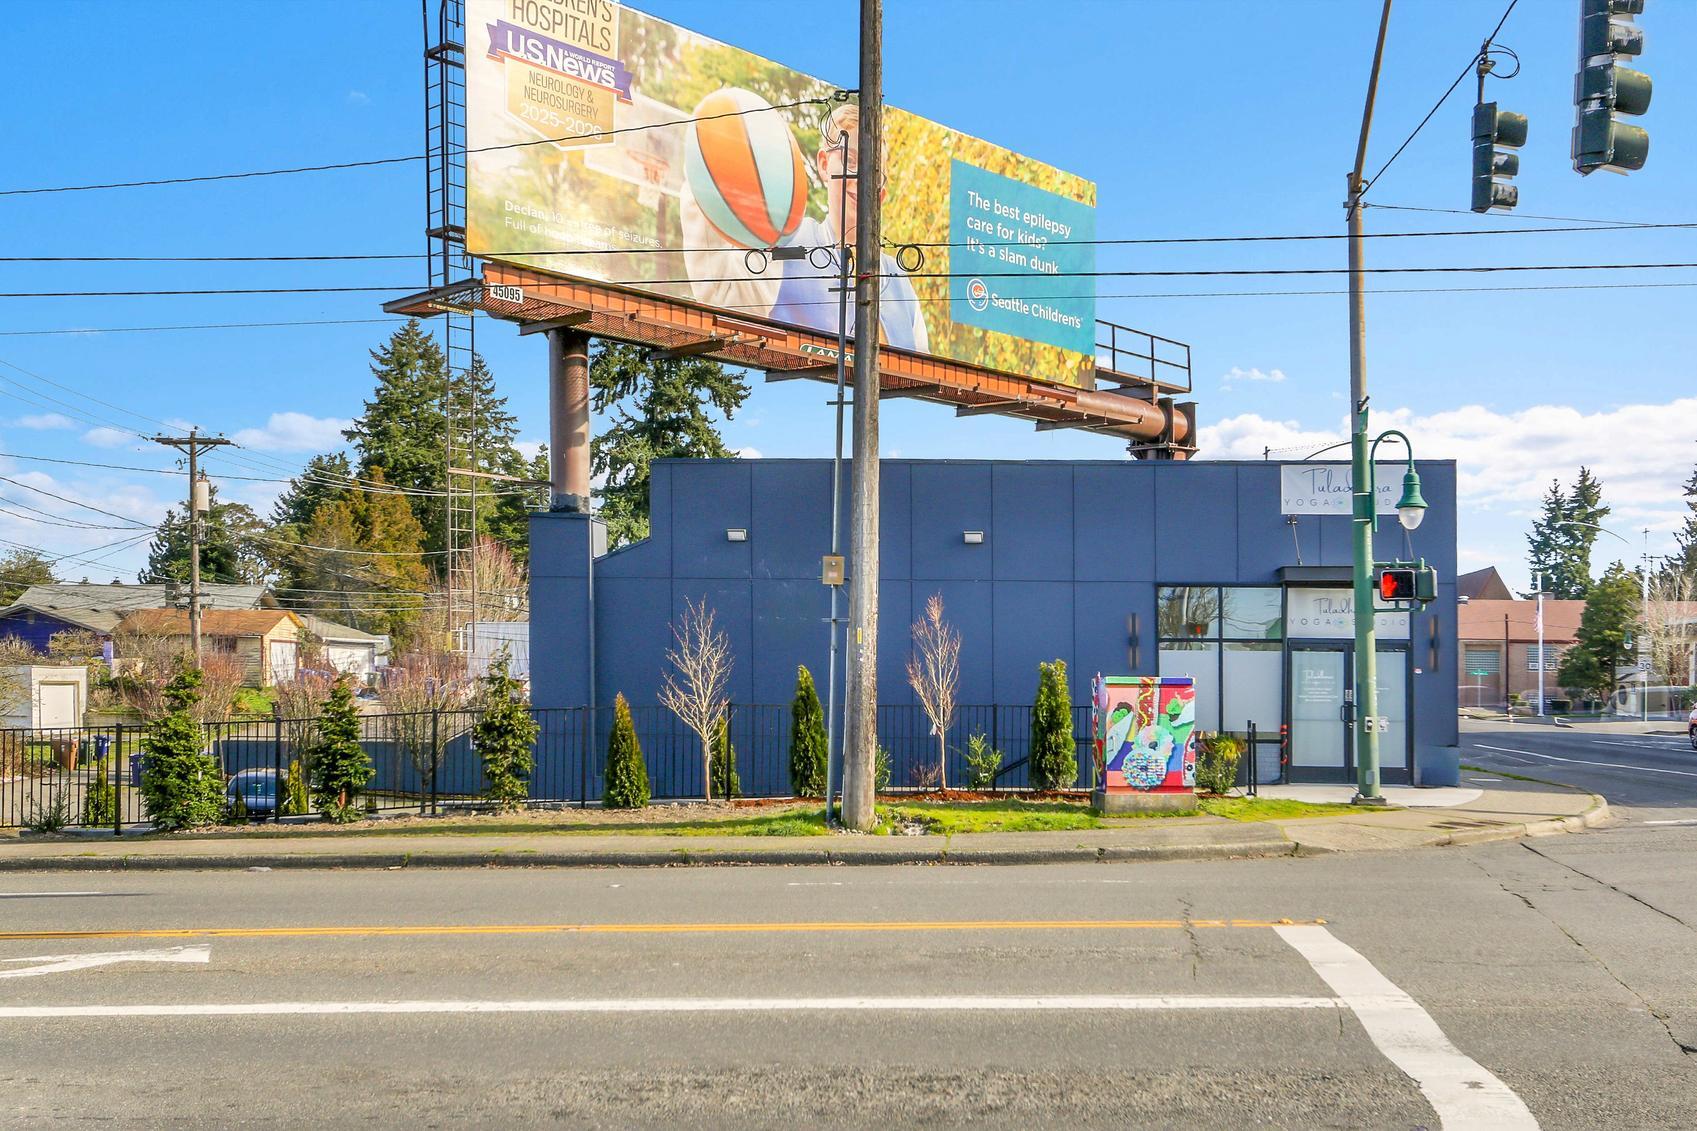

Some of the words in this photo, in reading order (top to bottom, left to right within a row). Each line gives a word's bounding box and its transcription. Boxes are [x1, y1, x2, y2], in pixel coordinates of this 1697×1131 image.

[512, 0, 611, 52] HOSPITALS
[528, 70, 585, 98] NEUROLOGY
[587, 90, 594, 103] &
[524, 85, 599, 120] NEUROSURGERY
[504, 216, 526, 233] Full
[529, 223, 542, 234] of
[967, 191, 991, 211] The
[994, 199, 1021, 221] best
[1023, 211, 1072, 239] epilepsy
[619, 229, 664, 249] seizures.
[967, 216, 993, 235] care
[997, 223, 1015, 241] for
[1018, 228, 1048, 251] kids?
[988, 246, 996, 258] a
[999, 246, 1027, 267] slam
[492, 285, 521, 302] 45095
[991, 293, 1029, 314] Seattle
[1284, 498, 1331, 507] YOGA
[1289, 618, 1331, 626] YOGA
[1639, 662, 1651, 670] 30
